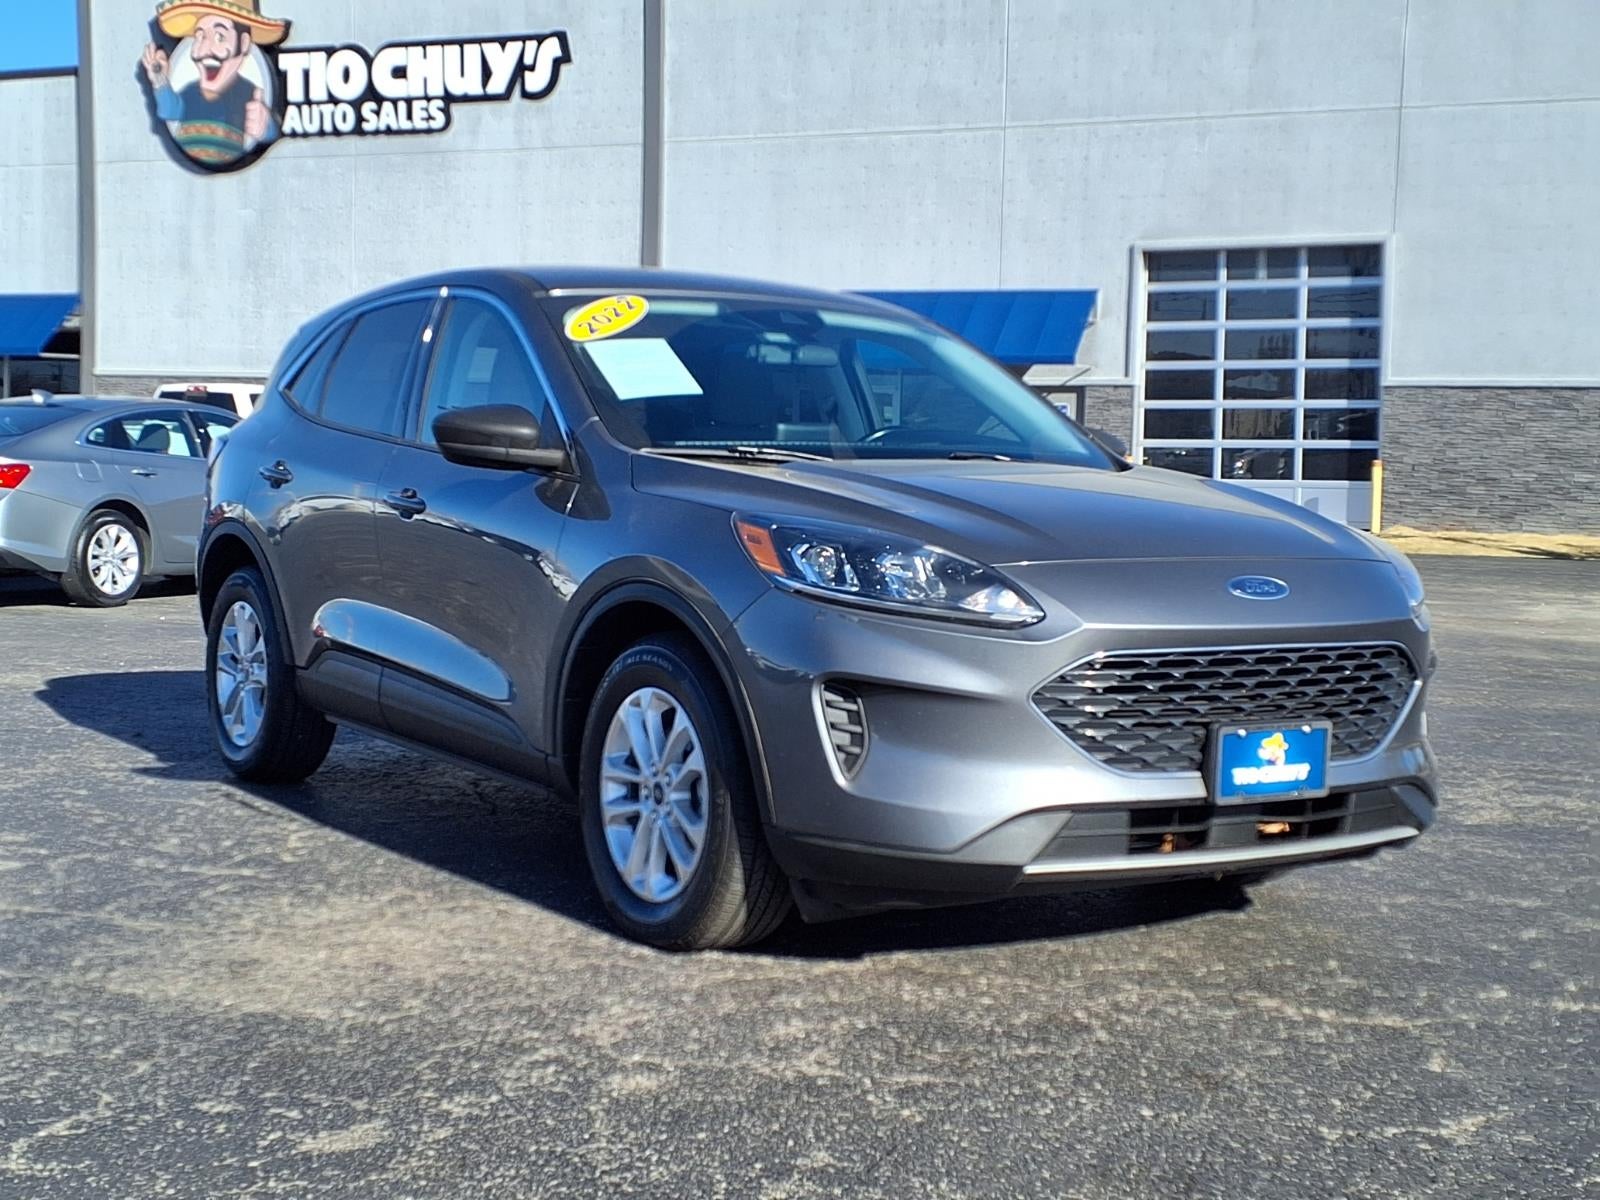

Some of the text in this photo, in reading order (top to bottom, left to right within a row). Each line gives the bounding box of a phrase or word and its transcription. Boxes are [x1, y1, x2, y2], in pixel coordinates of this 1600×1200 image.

[278, 36, 562, 102] TIO CHUY'S
[282, 100, 446, 135] AUTO SALES
[578, 298, 636, 335] 2022
